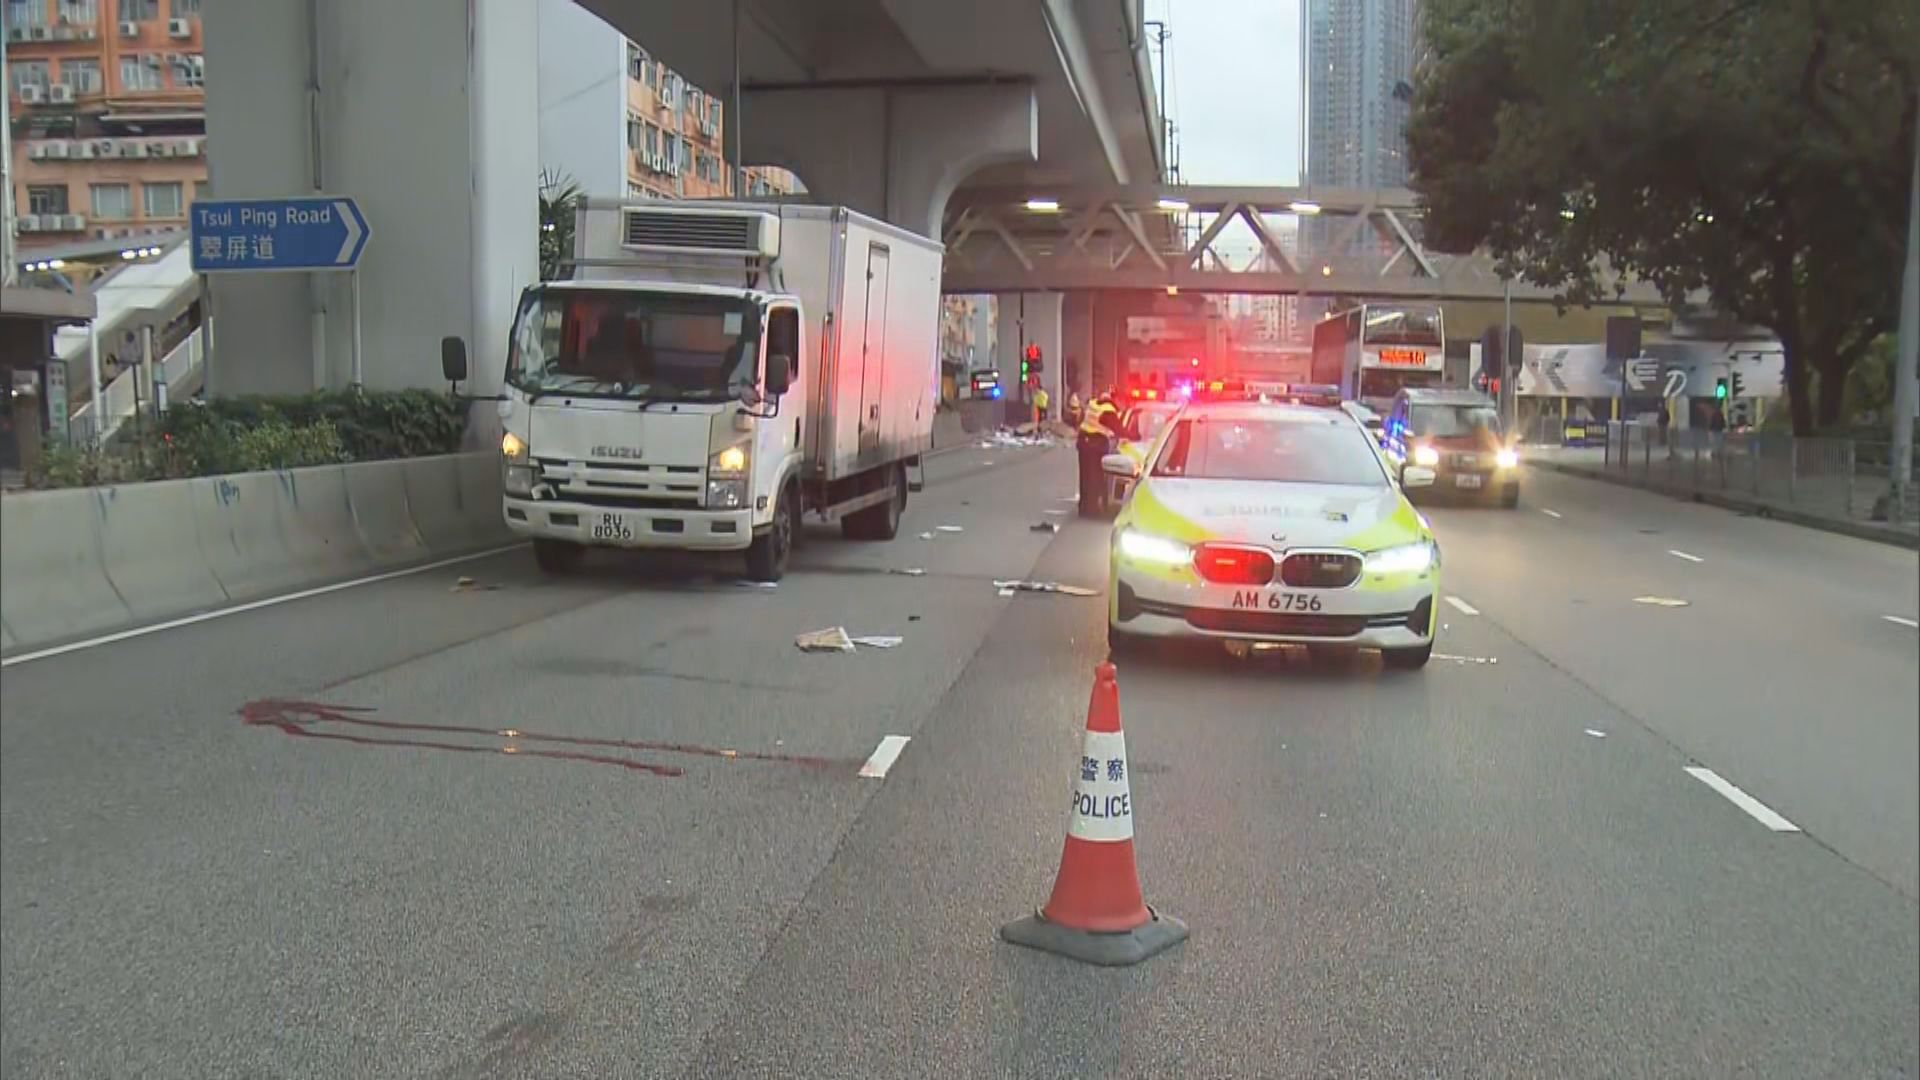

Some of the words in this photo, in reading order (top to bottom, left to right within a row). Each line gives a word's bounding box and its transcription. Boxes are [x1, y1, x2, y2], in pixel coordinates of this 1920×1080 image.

[200, 208, 232, 227] Tsui
[241, 207, 277, 229] Ping
[286, 206, 331, 225] Road
[200, 234, 275, 261] 翠屏道
[591, 446, 643, 459] ISUZU
[603, 513, 622, 527] RU
[594, 526, 631, 539] 8036
[1232, 590, 1259, 609] AM
[1268, 593, 1322, 611] 6756
[1081, 756, 1124, 781] 警察
[1072, 790, 1129, 818] POLICE
